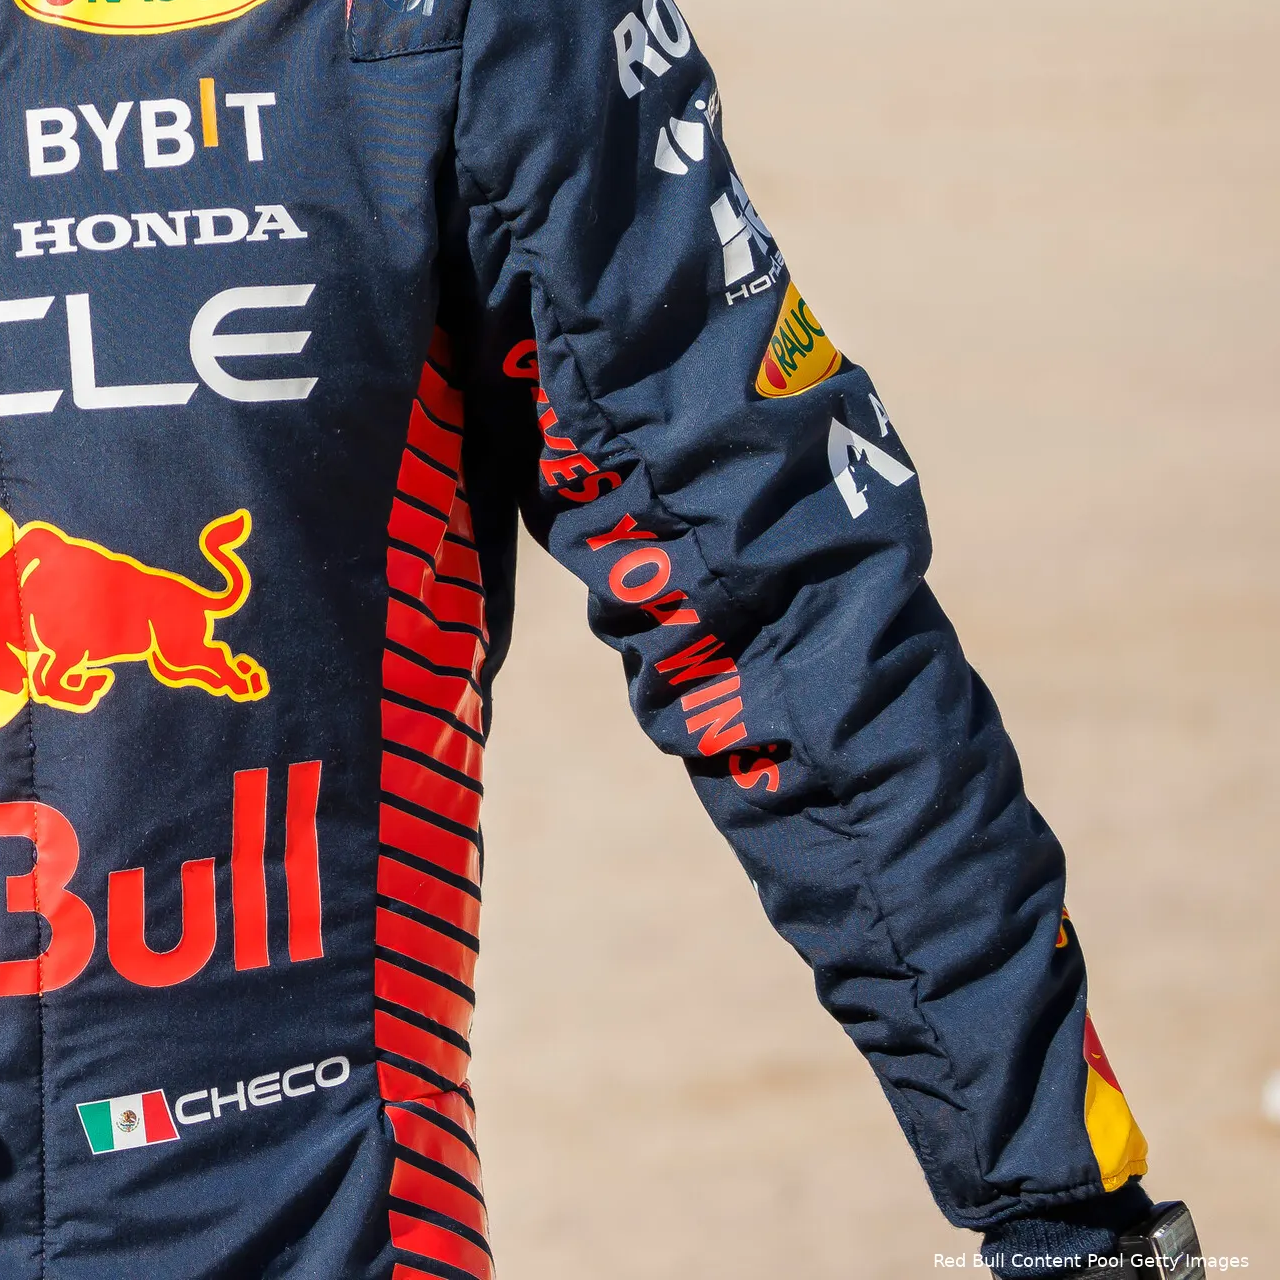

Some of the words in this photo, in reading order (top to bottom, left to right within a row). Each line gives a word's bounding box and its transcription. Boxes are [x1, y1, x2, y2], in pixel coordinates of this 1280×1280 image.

[24, 77, 276, 178] BYBIT
[13, 204, 308, 259] HONDA
[173, 1055, 351, 1125] CHECO
